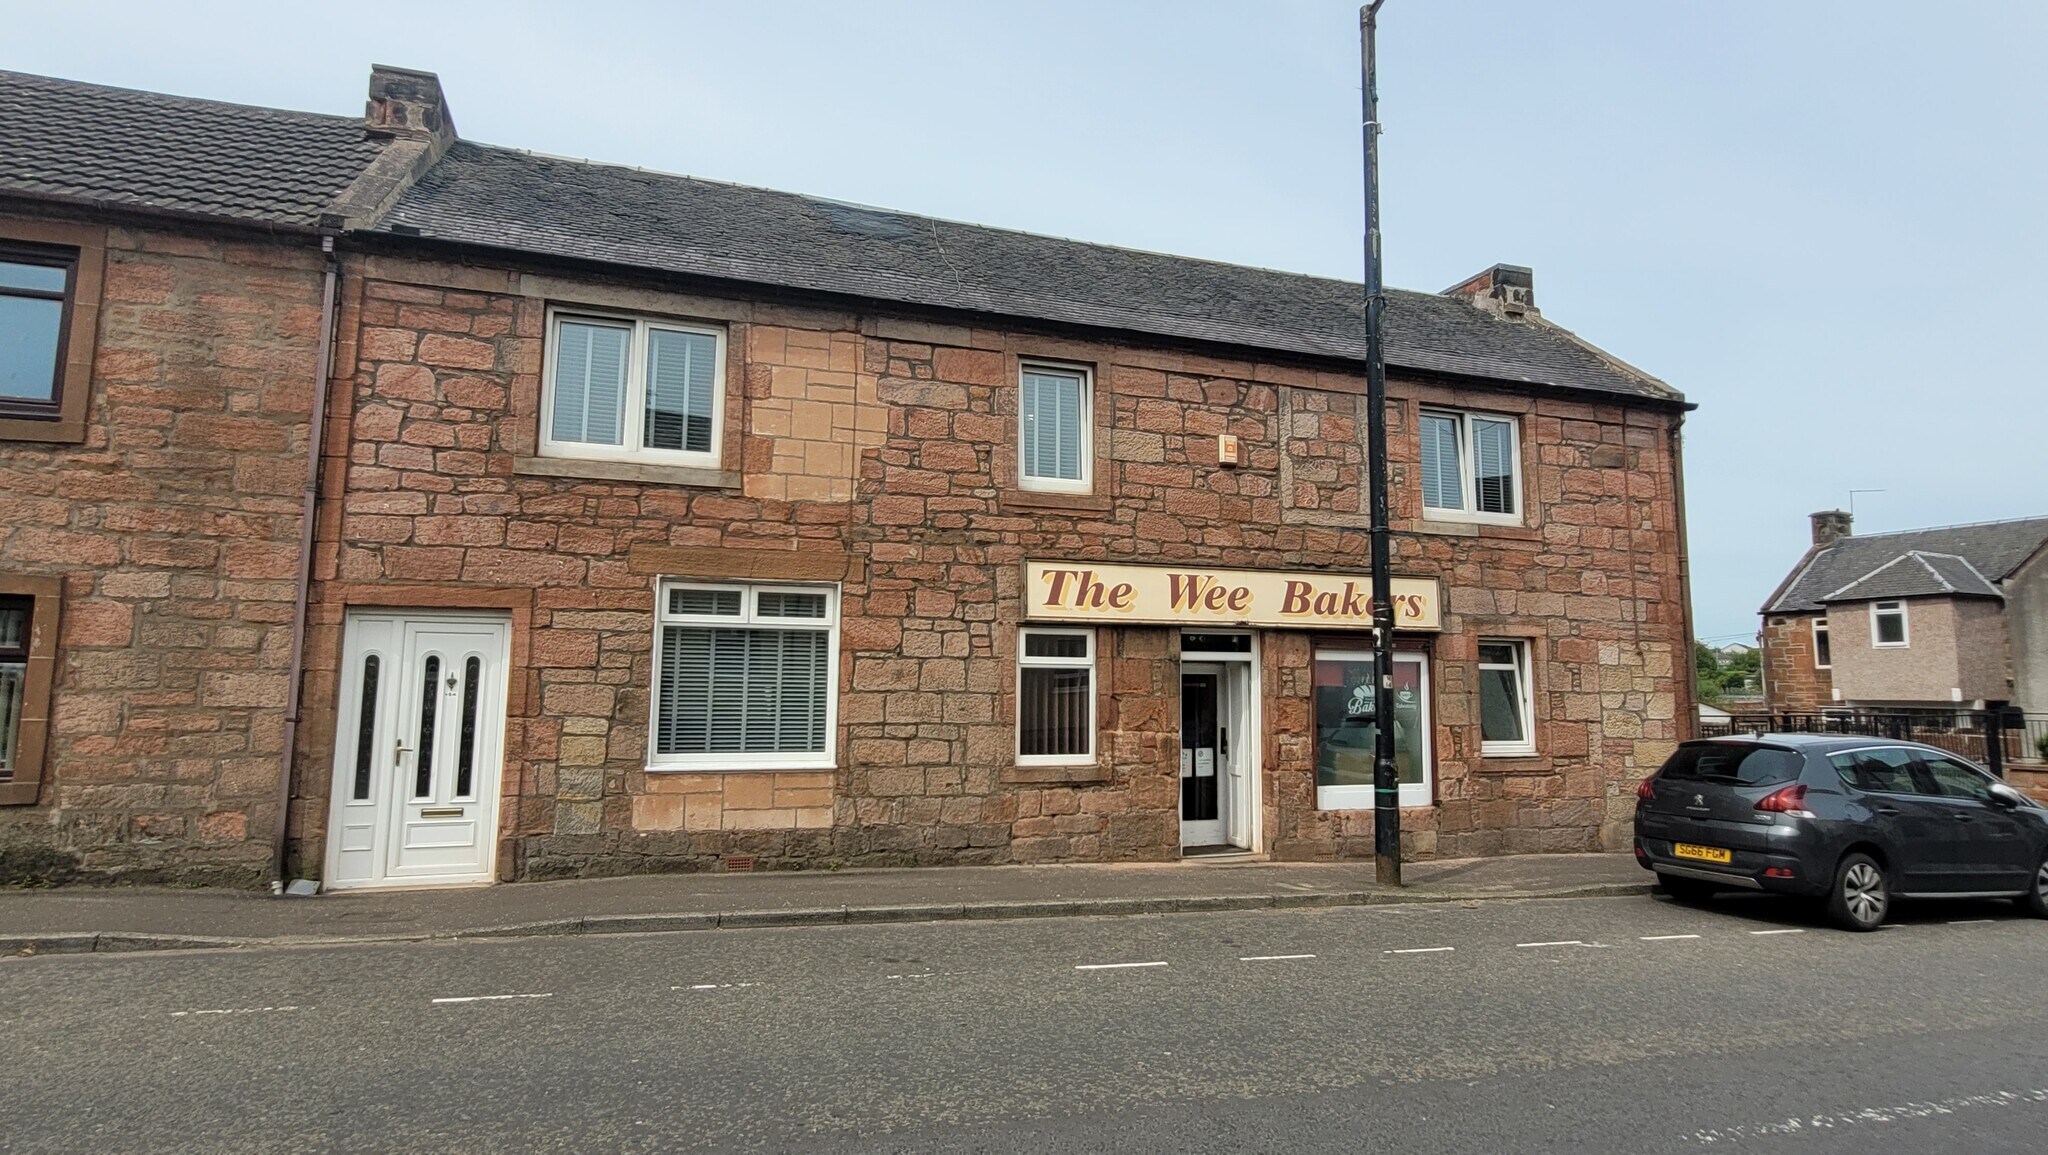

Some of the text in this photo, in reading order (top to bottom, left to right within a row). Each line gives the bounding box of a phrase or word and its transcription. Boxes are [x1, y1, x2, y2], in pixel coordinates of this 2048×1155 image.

[1041, 569, 1135, 610] The
[1167, 573, 1251, 612] Wee
[1348, 697, 1376, 715] Bak
[1679, 844, 1703, 857] SG66
